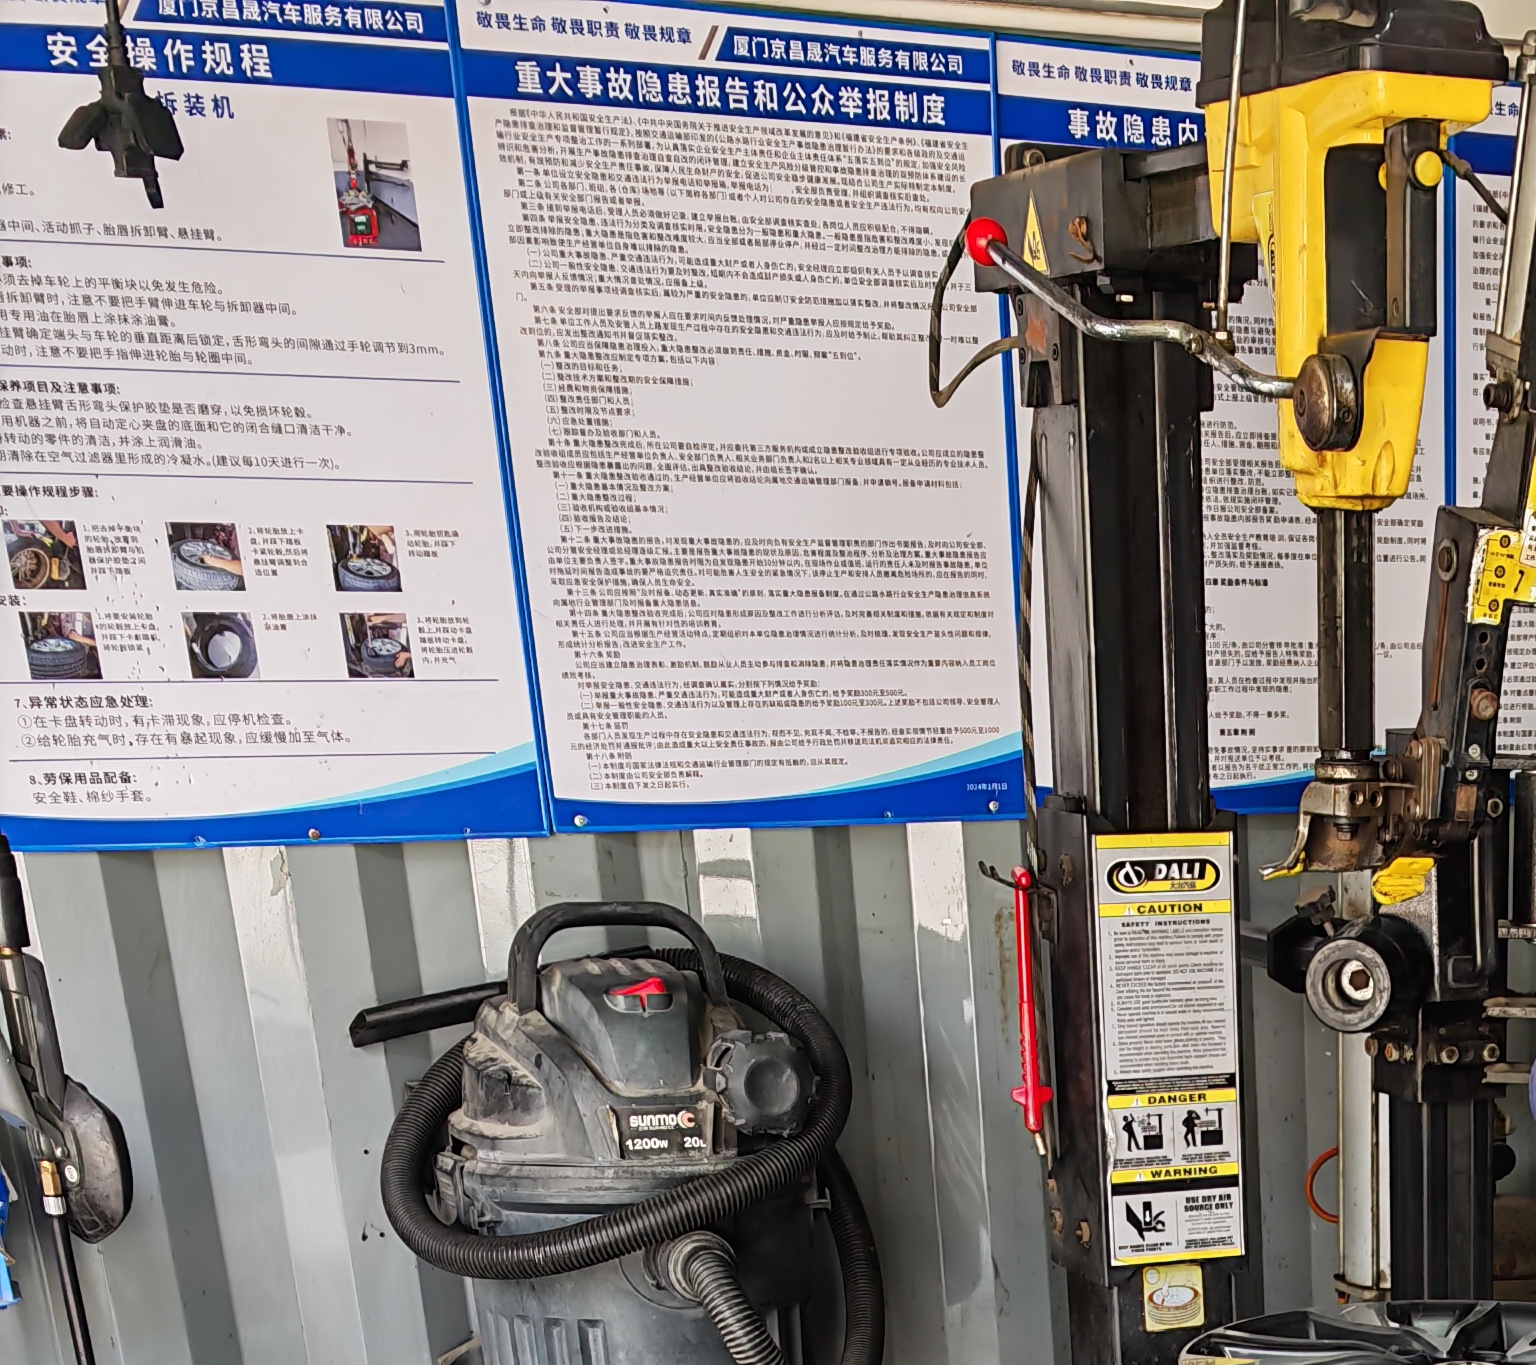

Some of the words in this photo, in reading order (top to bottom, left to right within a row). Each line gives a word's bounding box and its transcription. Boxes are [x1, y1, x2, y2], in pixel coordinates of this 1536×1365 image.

[157, 0, 424, 33] 厦门京昌晟汽车服务有限公司
[476, 11, 547, 34] 敬畏生命
[551, 17, 621, 40] 敬畏职责
[625, 22, 693, 45] 敬畏规章
[46, 32, 273, 79] 安全操作规程
[733, 34, 964, 75] 厦门京昌晟汽车服务有限公司
[1012, 59, 1070, 81] 敬畏生命
[1074, 66, 1132, 87] 敬畏职责
[1136, 72, 1192, 93] 敬畏规章
[515, 60, 946, 127] 重大事故隐患报告和公众举报制度
[1068, 108, 1198, 147] 事故隐患内
[1154, 862, 1200, 880] DALI
[1136, 902, 1203, 915] CAUTION
[1154, 919, 1211, 927] INSTRUCTIONS
[1147, 1092, 1208, 1105] DANGER
[683, 1136, 707, 1149] 20L
[1150, 1165, 1219, 1179] WARNING
[1184, 1203, 1214, 1212] SOURCE
[1215, 1202, 1234, 1211] ONLY
[1185, 1196, 1200, 1204] USE
[1202, 1195, 1217, 1203] DRY
[1219, 1193, 1232, 1202] AIR
